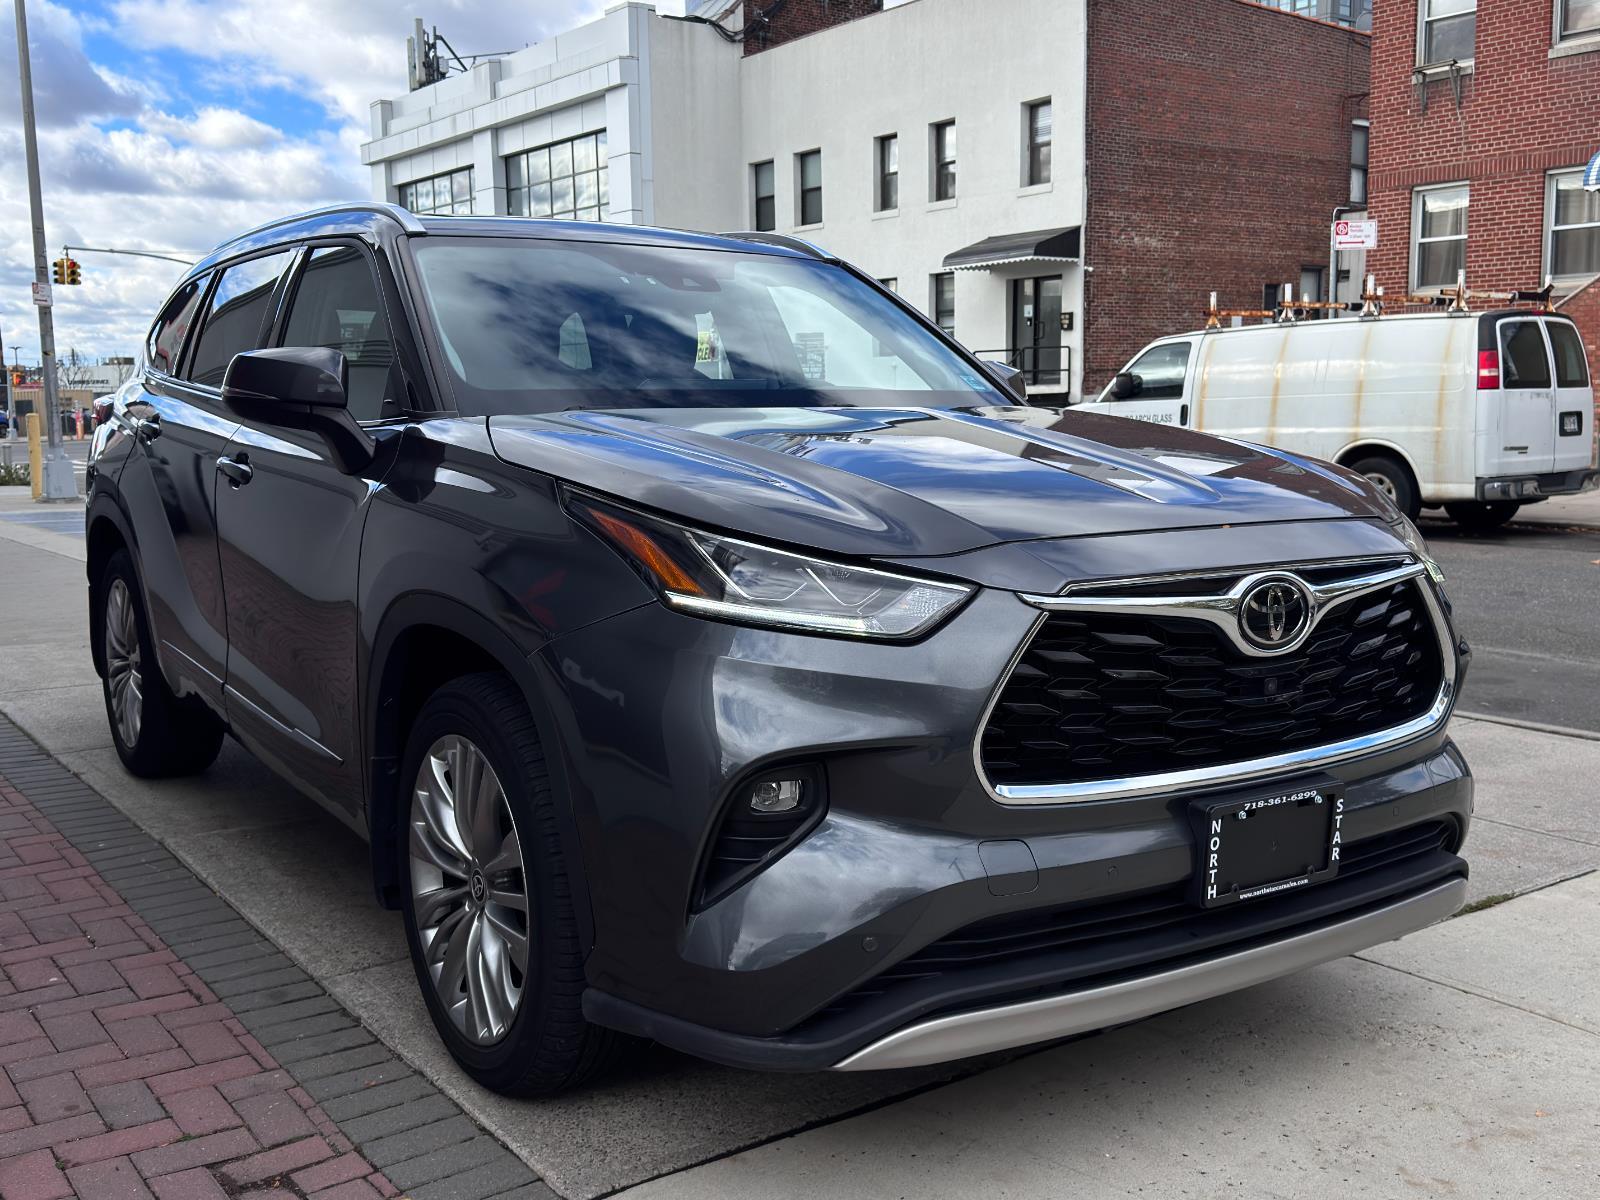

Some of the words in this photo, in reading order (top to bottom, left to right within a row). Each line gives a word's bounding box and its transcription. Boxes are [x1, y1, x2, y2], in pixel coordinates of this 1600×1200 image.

[1152, 413, 1172, 423] GLASS
[1244, 790, 1317, 811] 718-361-6299
[1331, 798, 1344, 861] STAR
[1207, 819, 1222, 899] NORTH
